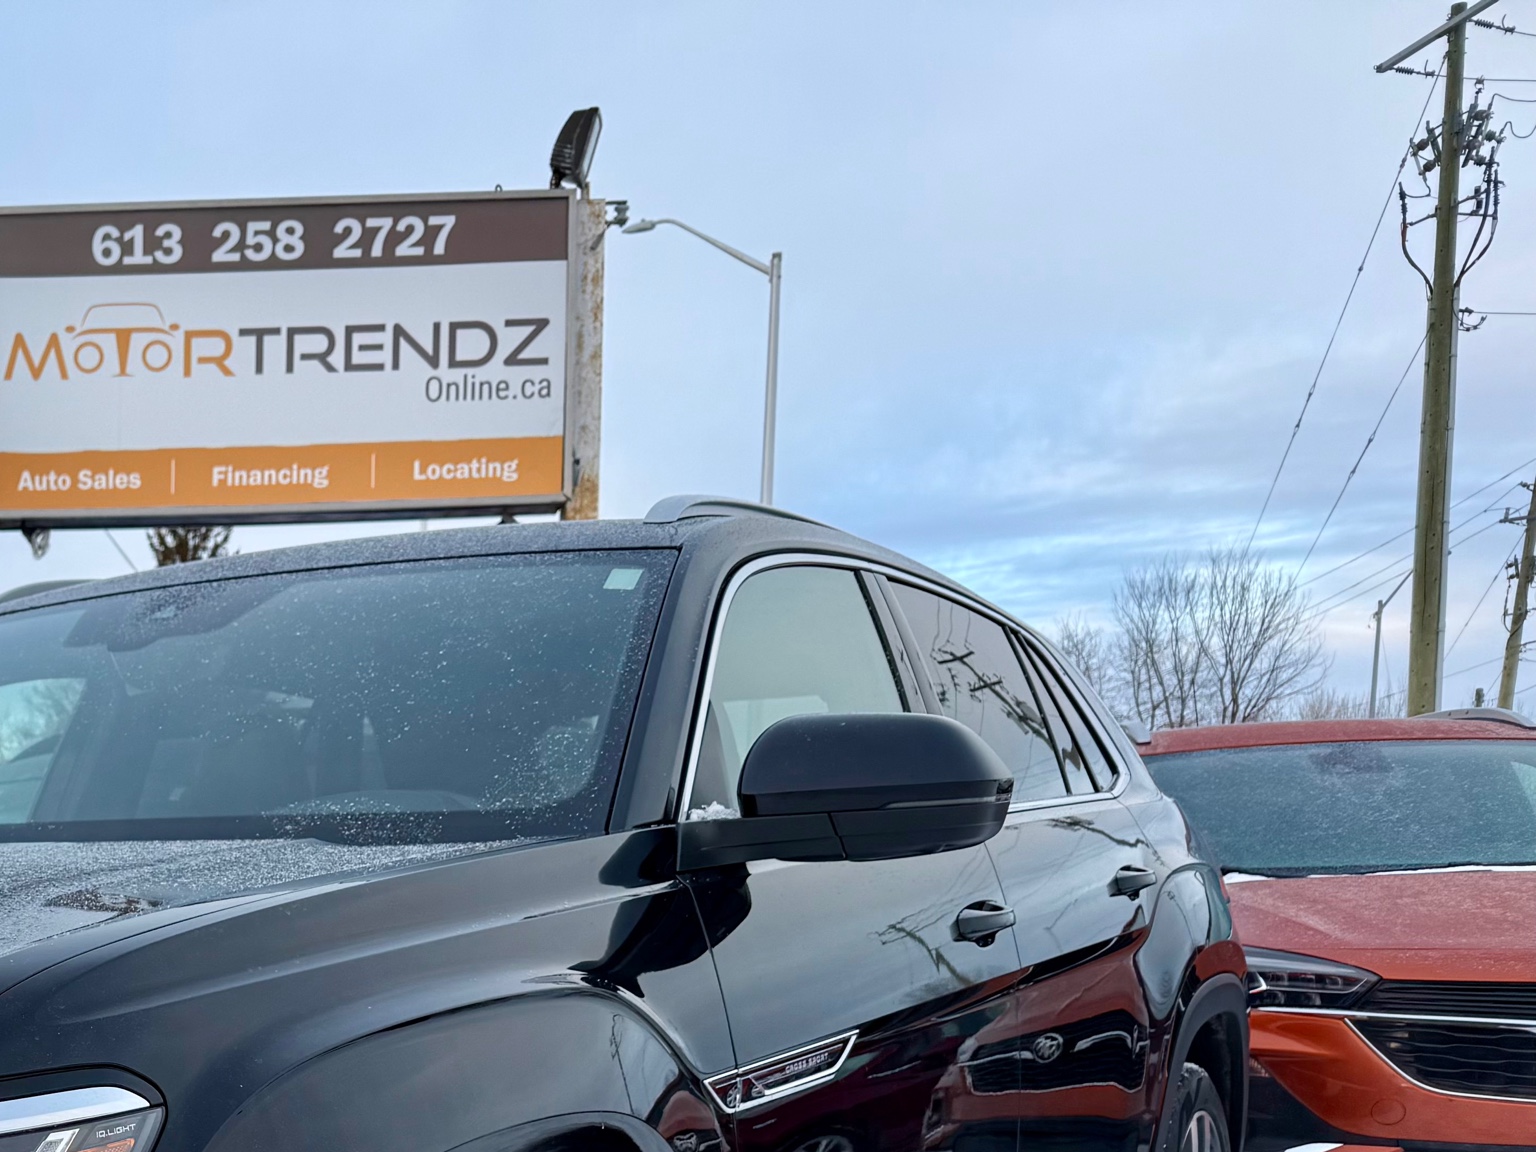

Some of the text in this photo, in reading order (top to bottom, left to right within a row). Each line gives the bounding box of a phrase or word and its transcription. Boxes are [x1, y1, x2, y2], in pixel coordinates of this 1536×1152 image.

[91, 214, 457, 266] 613 258 2727
[425, 372, 552, 404] Online.ca
[17, 467, 142, 493] Auto Sales
[211, 463, 330, 489] Financing
[413, 457, 519, 484] Locating
[785, 1053, 828, 1073] CROSS SPORT
[96, 1123, 136, 1138] IQ.LIGHT
